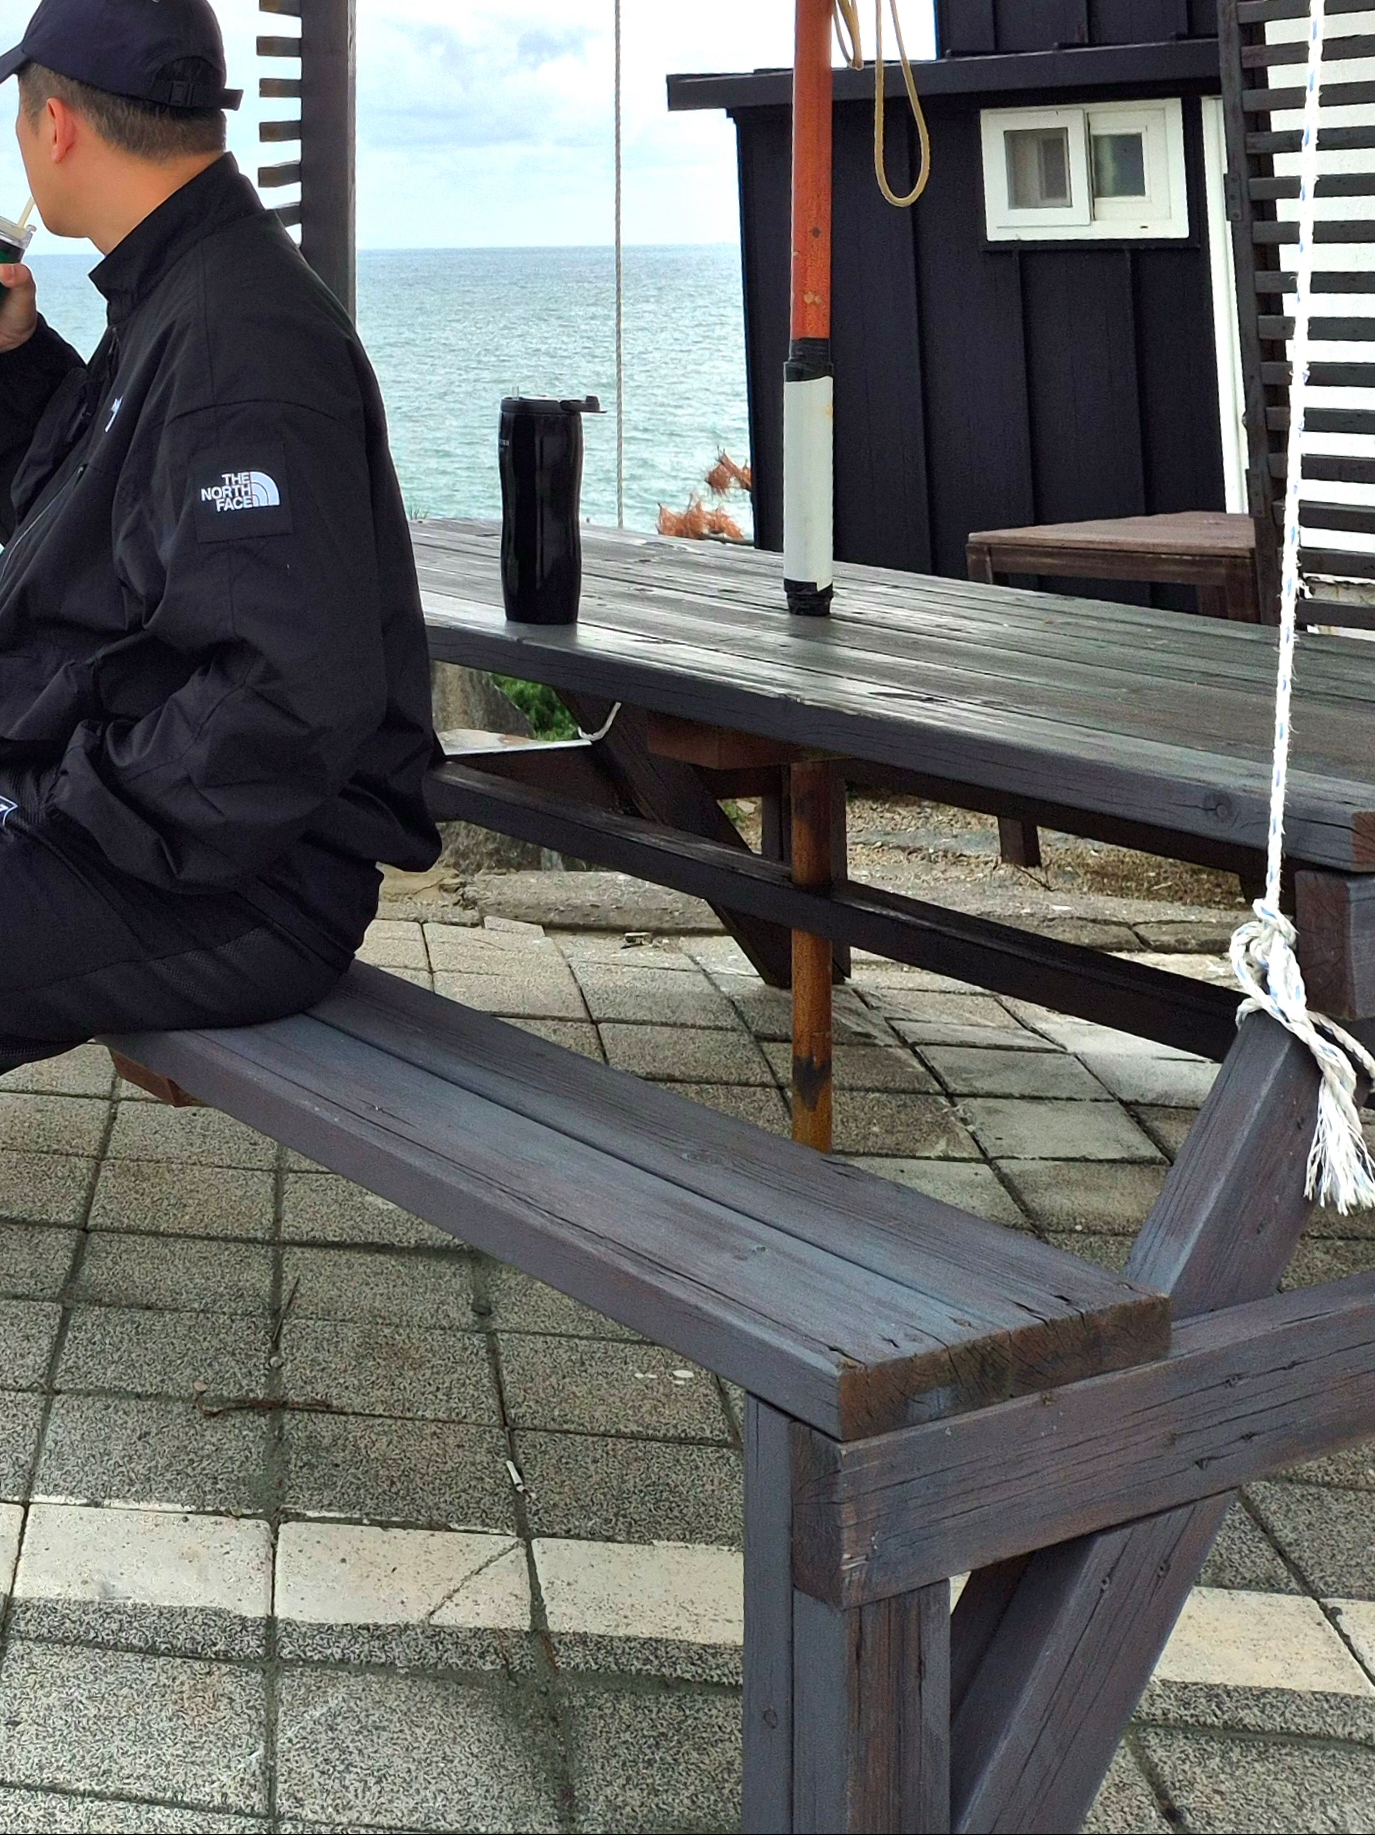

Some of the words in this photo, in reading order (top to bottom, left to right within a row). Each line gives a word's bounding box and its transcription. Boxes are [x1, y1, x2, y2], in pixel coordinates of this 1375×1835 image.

[221, 472, 250, 486] THE
[200, 483, 251, 501] NORTH
[216, 496, 253, 512] FACE
